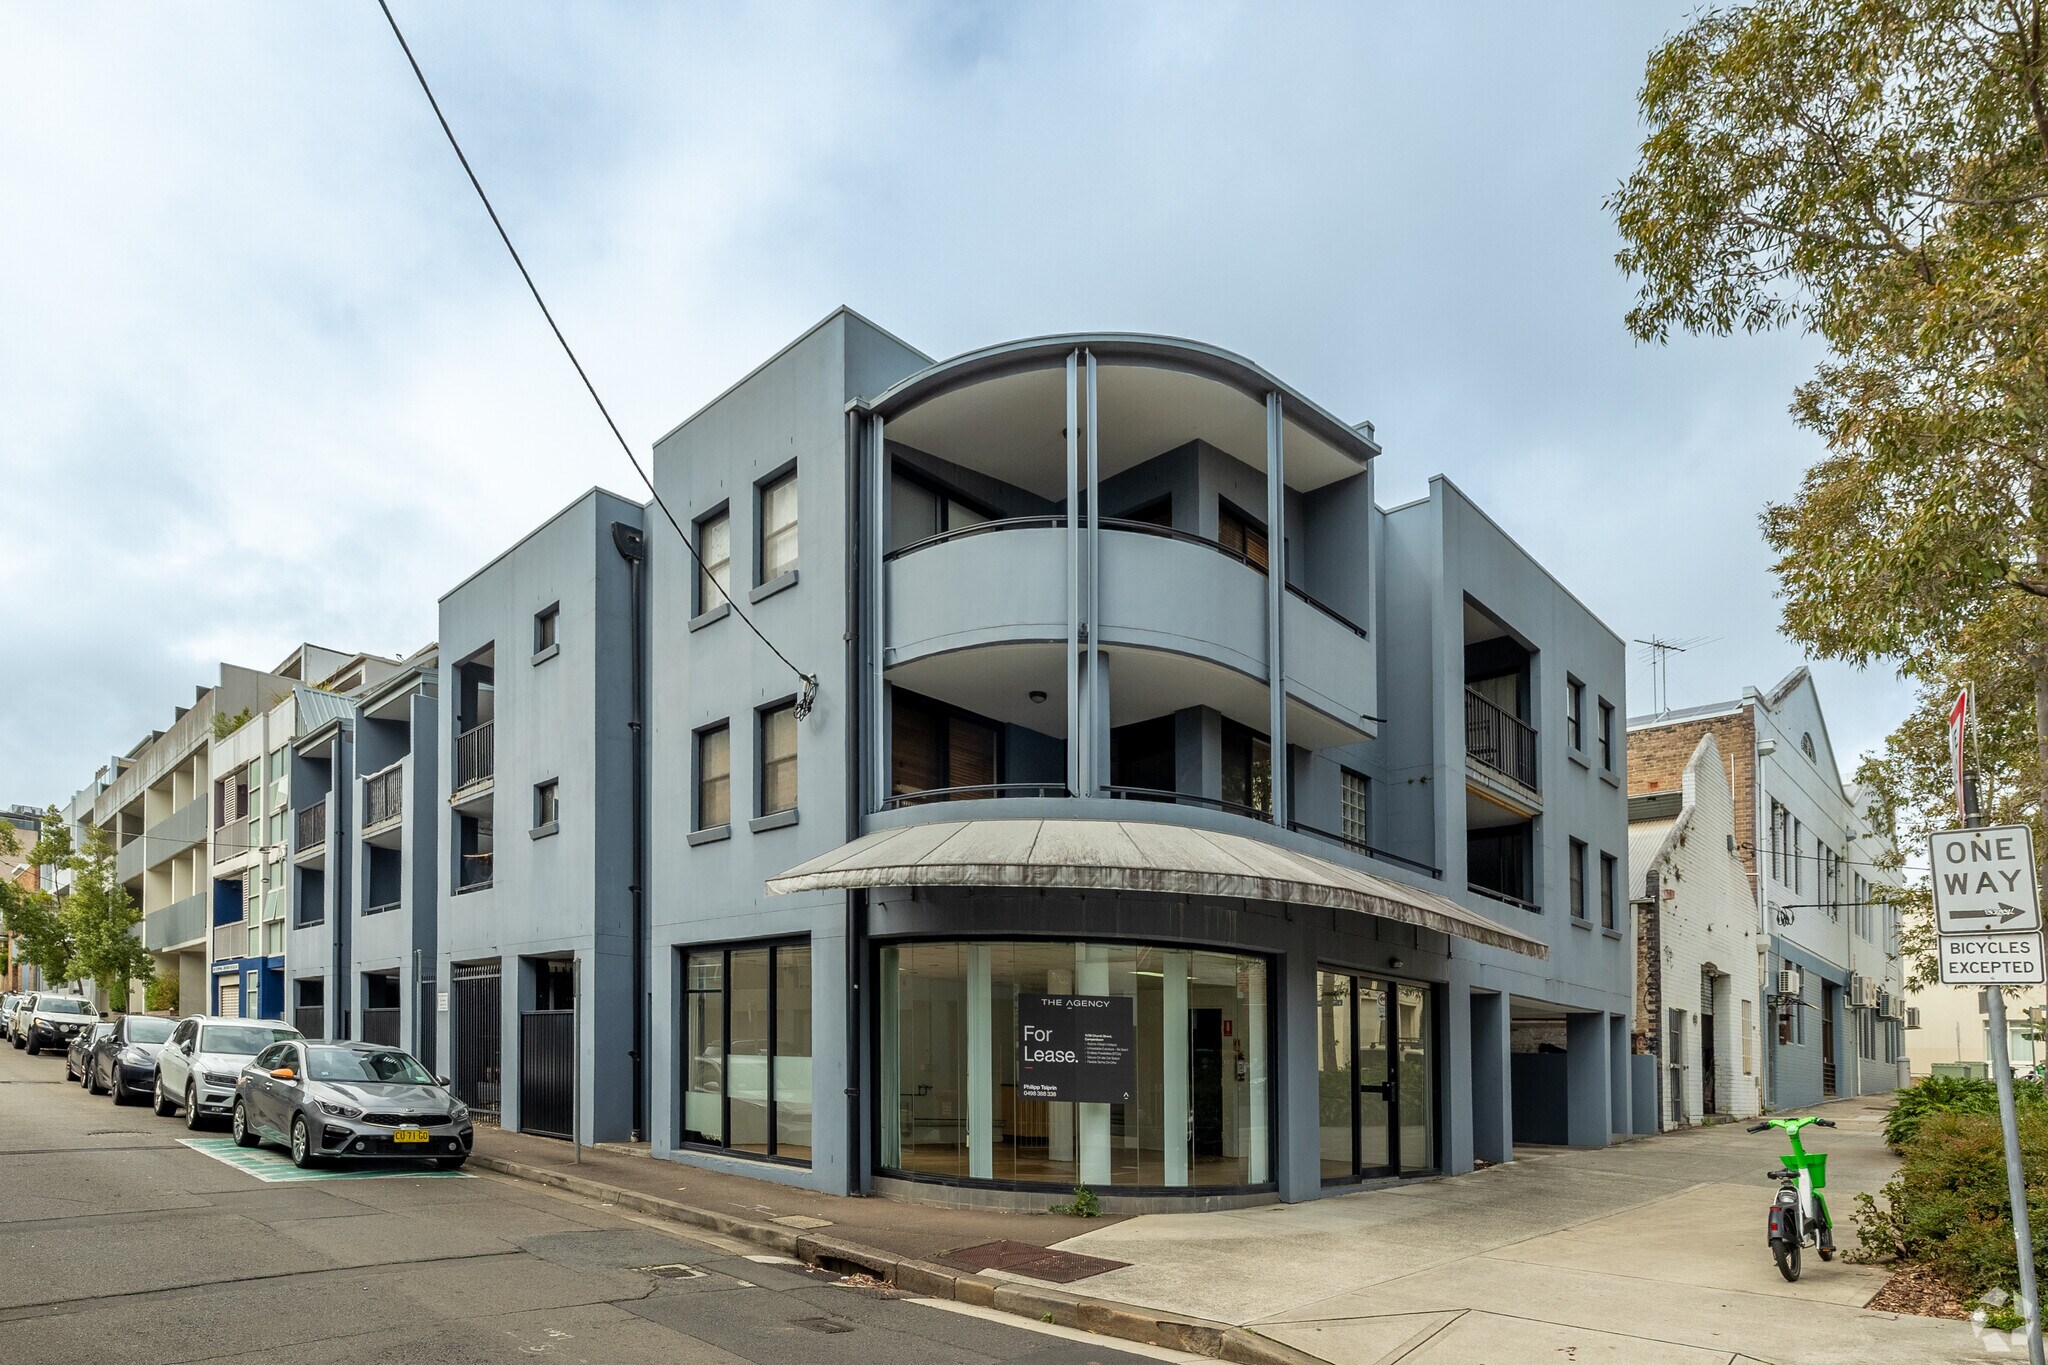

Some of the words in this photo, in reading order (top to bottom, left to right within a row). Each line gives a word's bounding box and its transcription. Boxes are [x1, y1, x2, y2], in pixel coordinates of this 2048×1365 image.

[1946, 837, 2015, 864] ONE
[1944, 869, 2022, 896] WAY
[1950, 941, 2031, 955] BICYCLES
[1949, 961, 2034, 974] EXCEPTED
[1041, 998, 1063, 1006] THE
[1066, 999, 1110, 1009] AGENCY
[1024, 1025, 1053, 1042] For
[1024, 1045, 1079, 1063] Lease.
